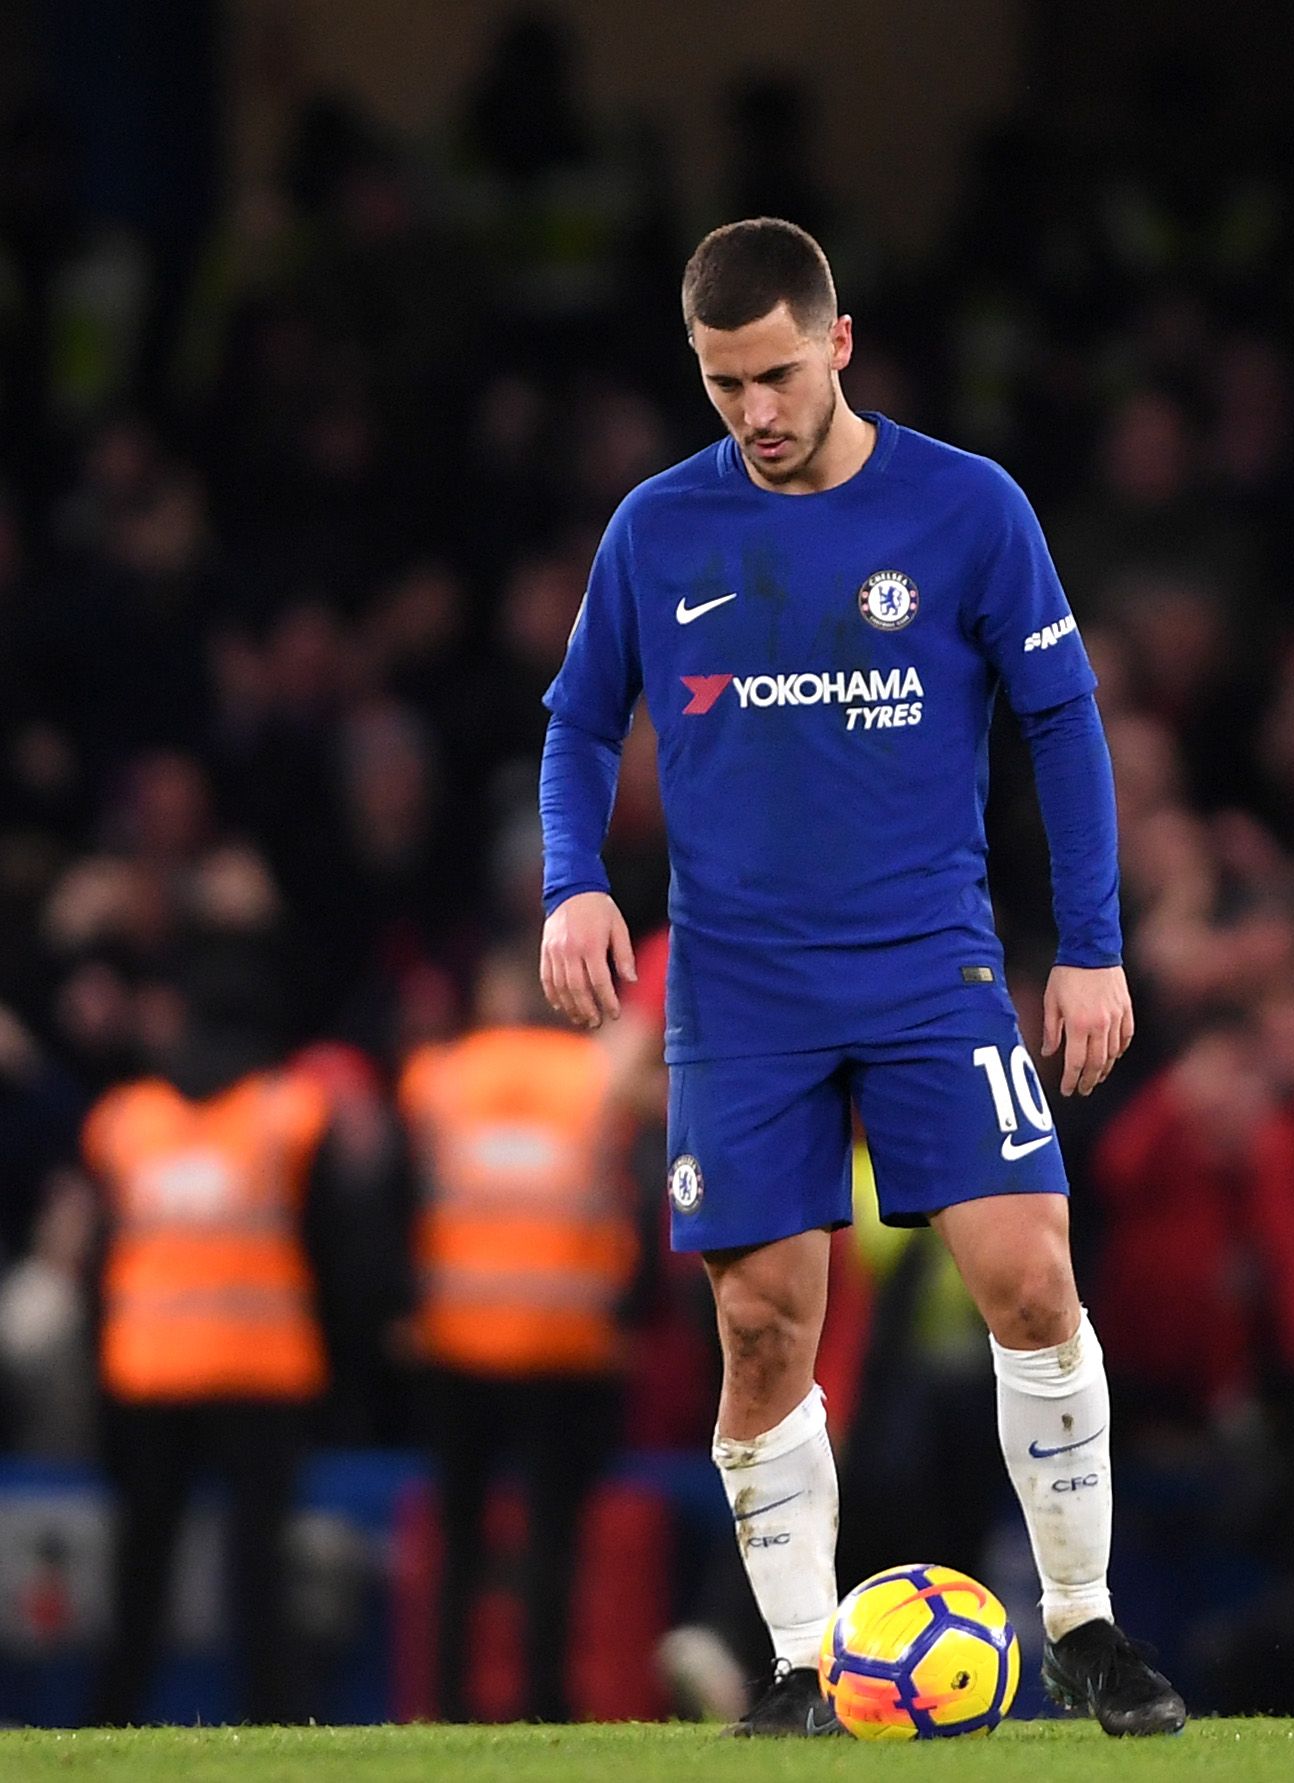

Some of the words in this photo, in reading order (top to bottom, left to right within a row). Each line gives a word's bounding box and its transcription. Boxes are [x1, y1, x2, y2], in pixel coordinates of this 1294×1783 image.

[732, 667, 925, 708] YOKOHAMA
[845, 702, 923, 731] TYRES
[973, 1045, 1053, 1133] 10
[1051, 1473, 1099, 1493] CFC
[746, 1532, 791, 1548] CFC
